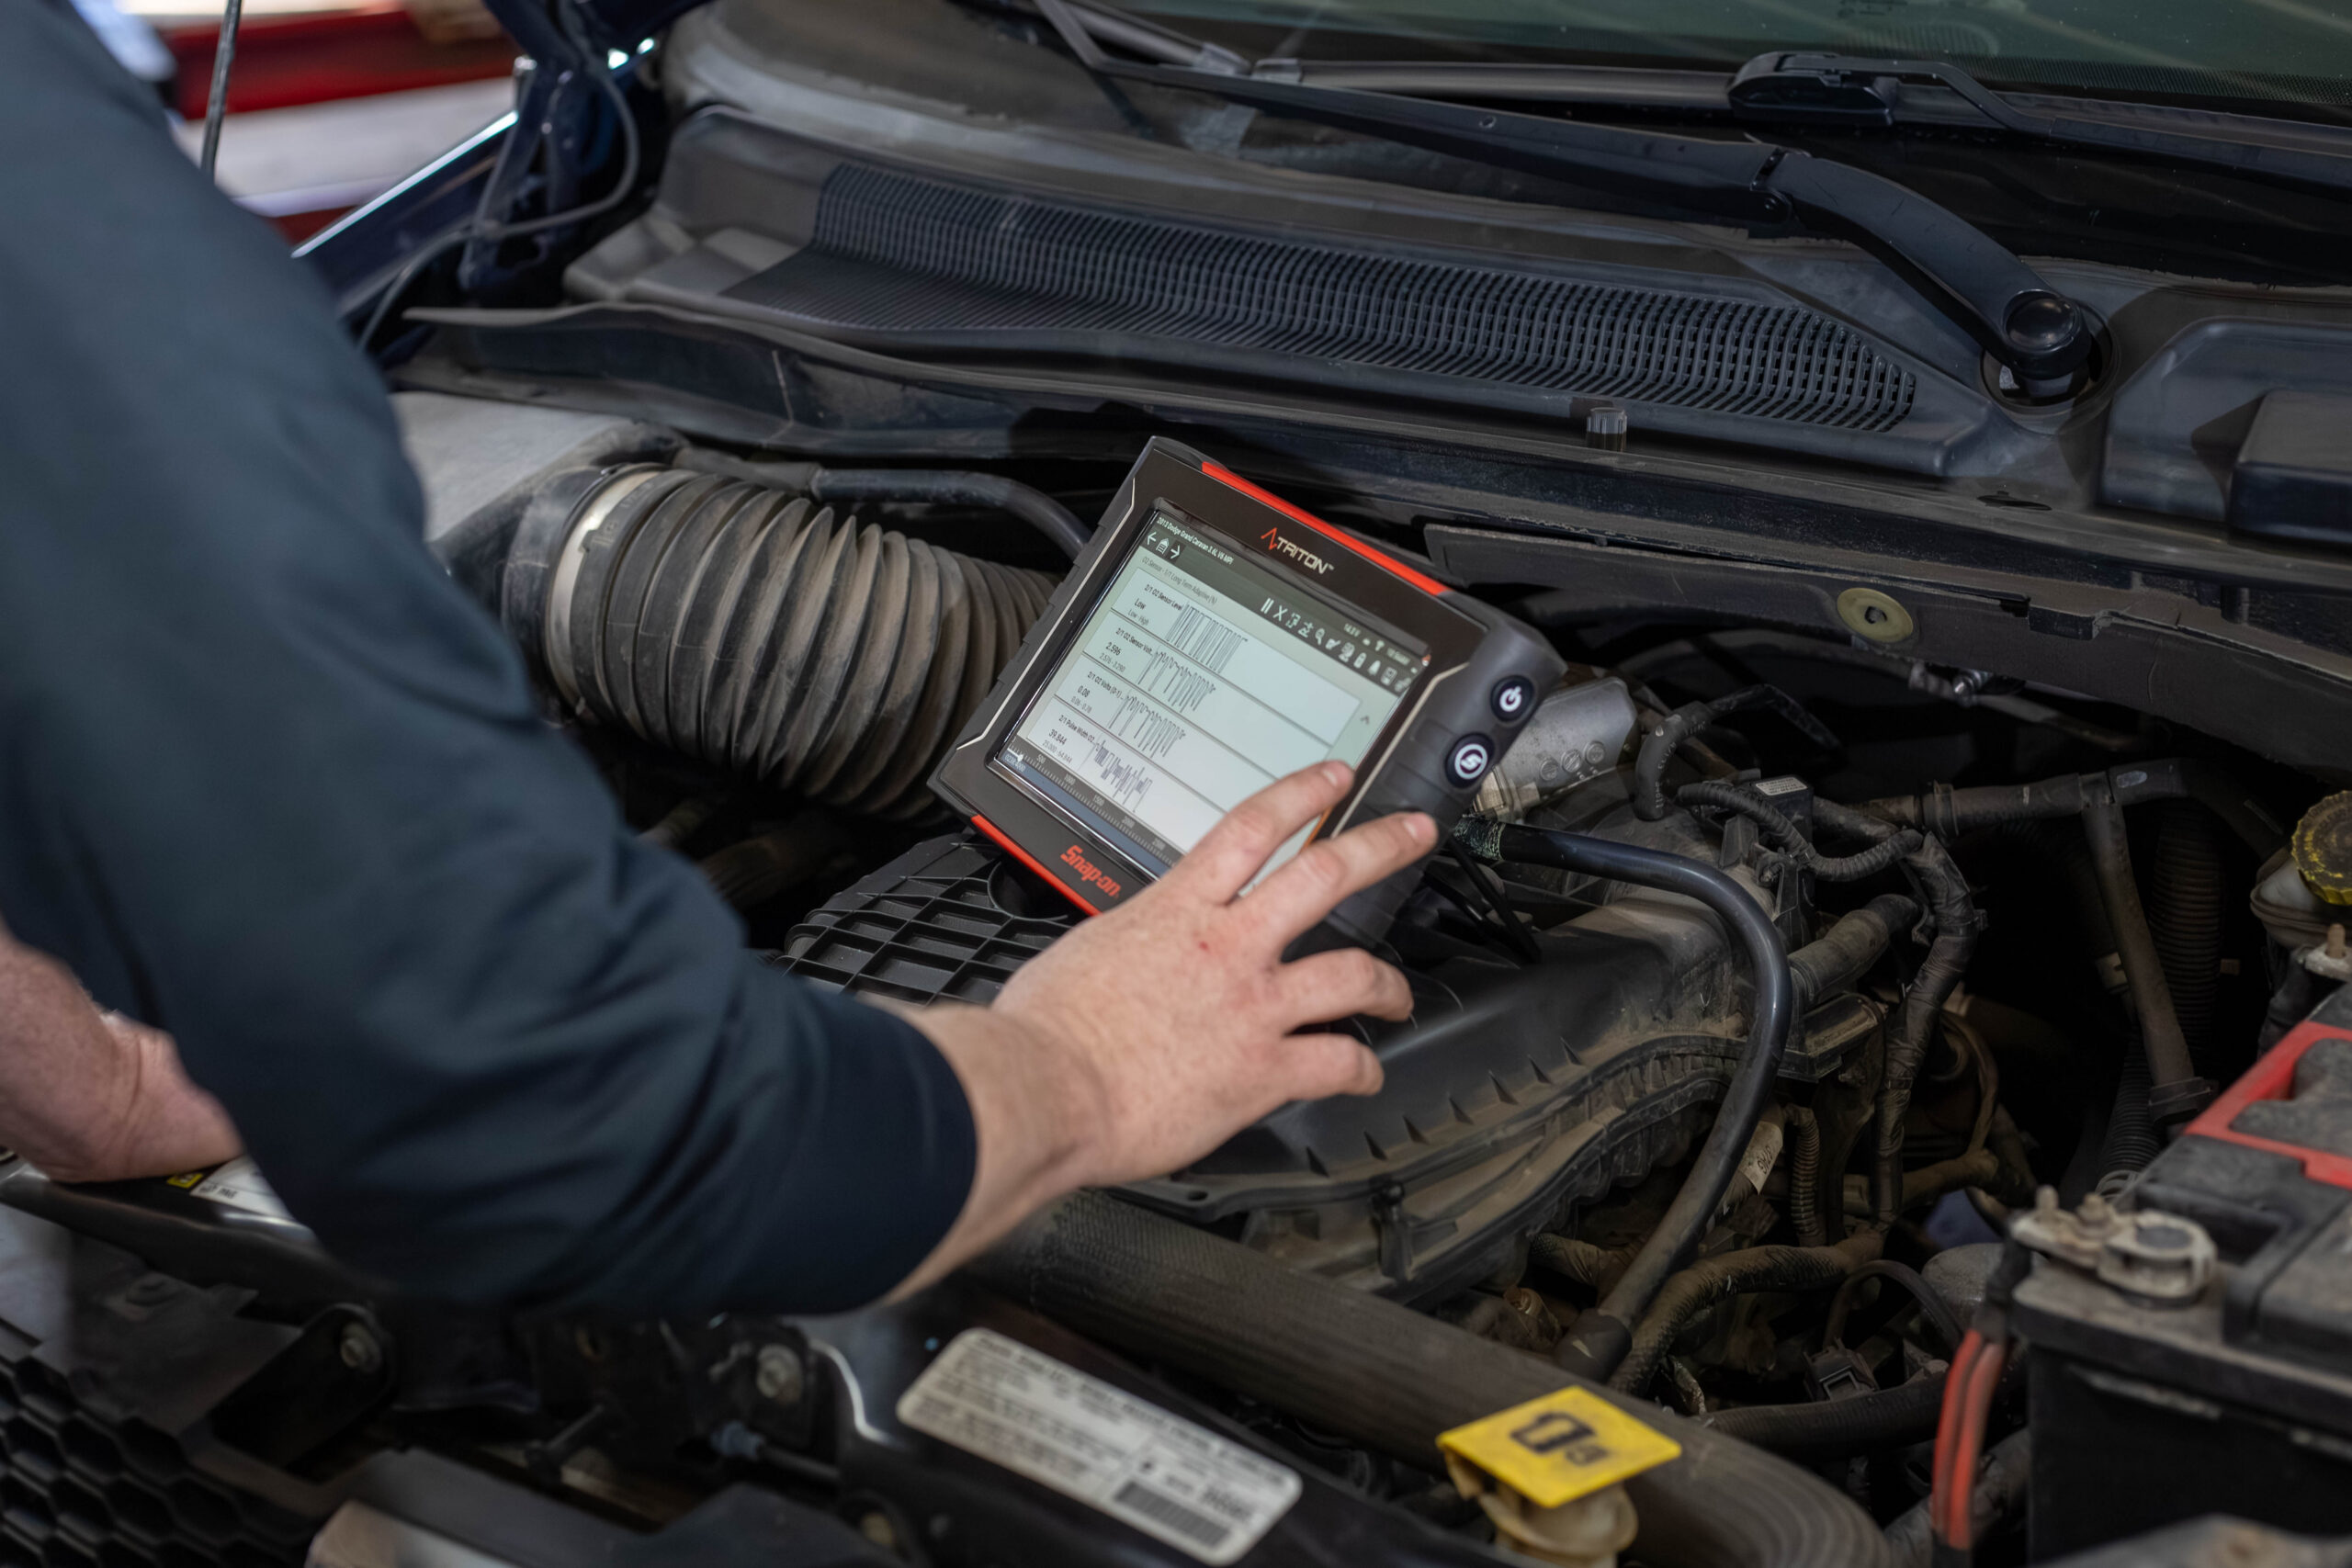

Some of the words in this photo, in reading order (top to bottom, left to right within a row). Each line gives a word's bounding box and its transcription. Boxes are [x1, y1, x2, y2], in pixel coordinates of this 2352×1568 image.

[1166, 522, 1181, 535] Dodge
[1180, 530, 1193, 542] Grand
[1192, 536, 1208, 550] Caravan
[1207, 545, 1217, 557] 3.6L
[1216, 551, 1225, 559] V6
[1222, 554, 1234, 564] MPI
[1148, 559, 1162, 571] Sensor
[1170, 572, 1182, 585] Long
[1181, 579, 1193, 589] Term
[1191, 585, 1210, 600] Adaptive
[1134, 597, 1146, 609] Low
[1157, 592, 1172, 604] Sensor
[1170, 601, 1182, 610] Level
[1105, 641, 1121, 655] 2.596
[1114, 626, 1125, 636] 2/1
[1128, 635, 1144, 649] Sensor
[1086, 671, 1096, 680] 2/1
[1100, 680, 1112, 691] Volts
[1065, 718, 1077, 730] Pulse
[1076, 727, 1088, 738] Width
[1035, 753, 1046, 764] 500
[1063, 773, 1076, 785] 1000
[1059, 844, 1121, 897] Snap-on
